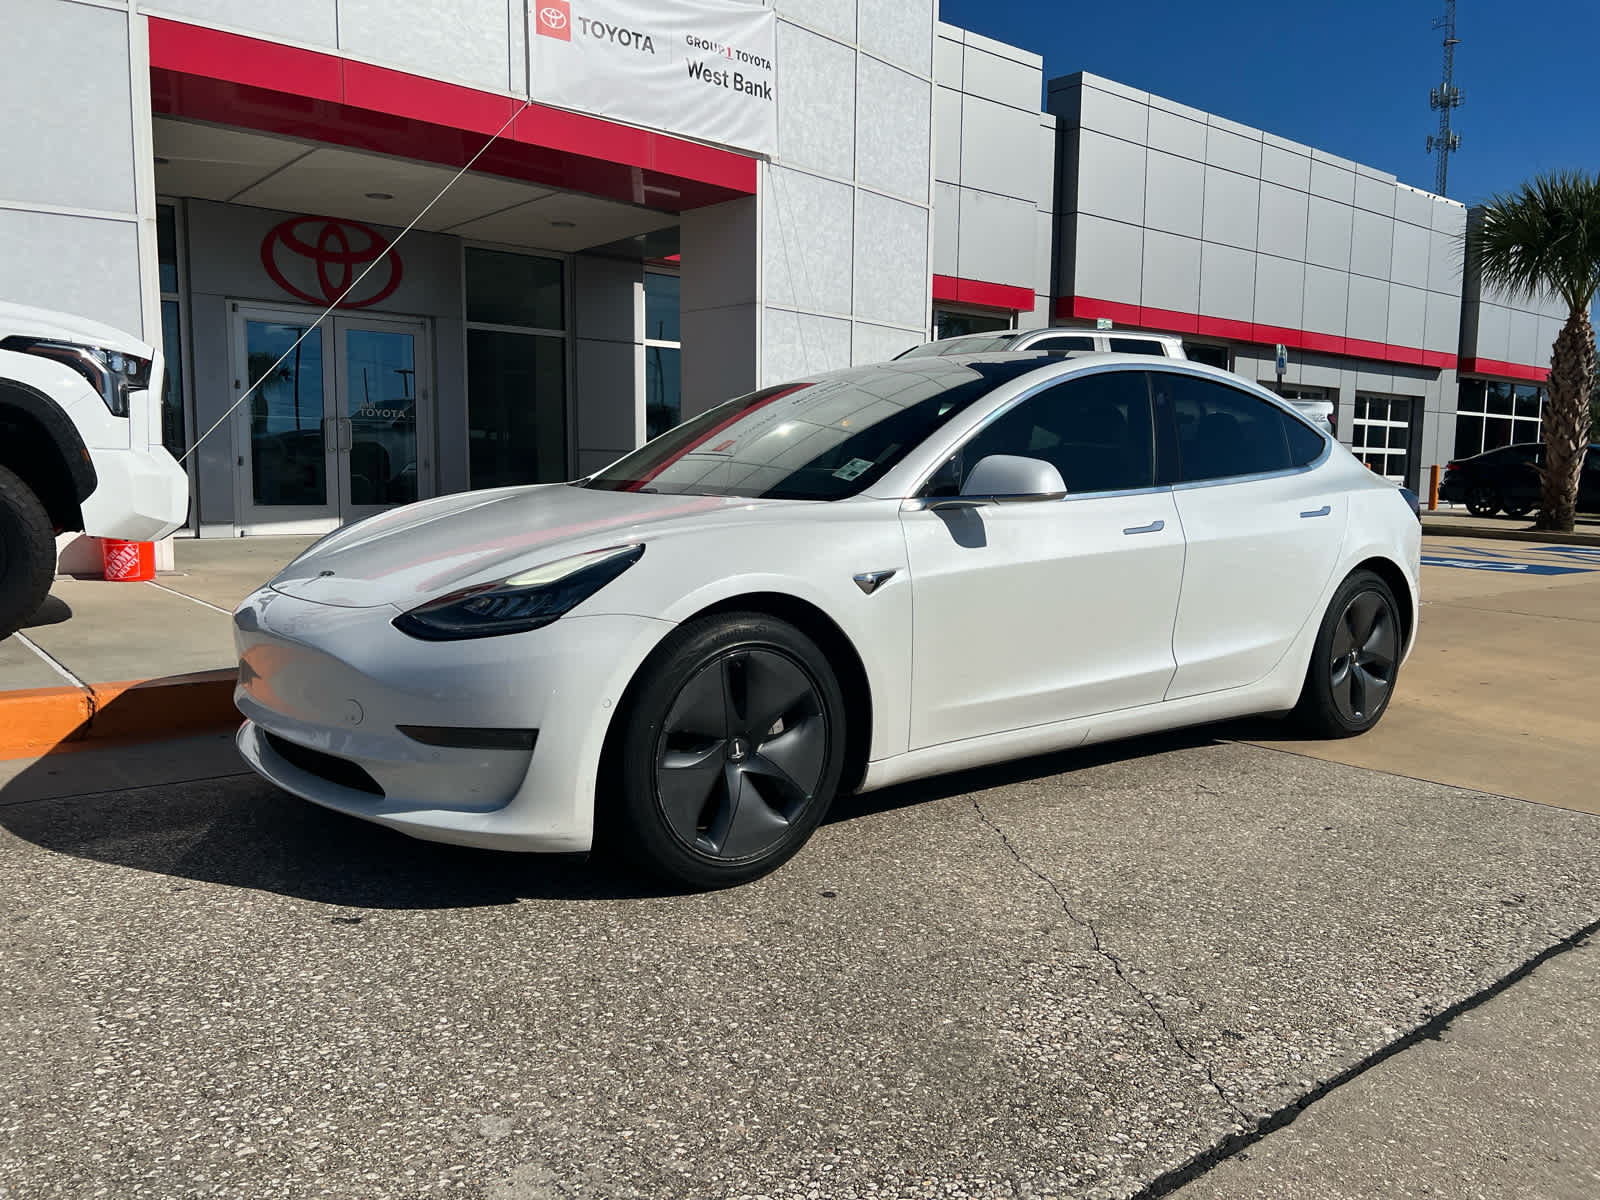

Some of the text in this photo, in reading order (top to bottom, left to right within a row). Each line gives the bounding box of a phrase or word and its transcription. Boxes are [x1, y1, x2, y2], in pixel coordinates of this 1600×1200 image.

[578, 16, 655, 54] TOYOTA
[686, 35, 725, 55] GROUP
[735, 50, 772, 71] TOYOTA
[686, 57, 772, 101] West Bank
[360, 408, 406, 418] TOYOTA
[106, 544, 138, 577] HOME
[117, 558, 138, 578] DEPOT
